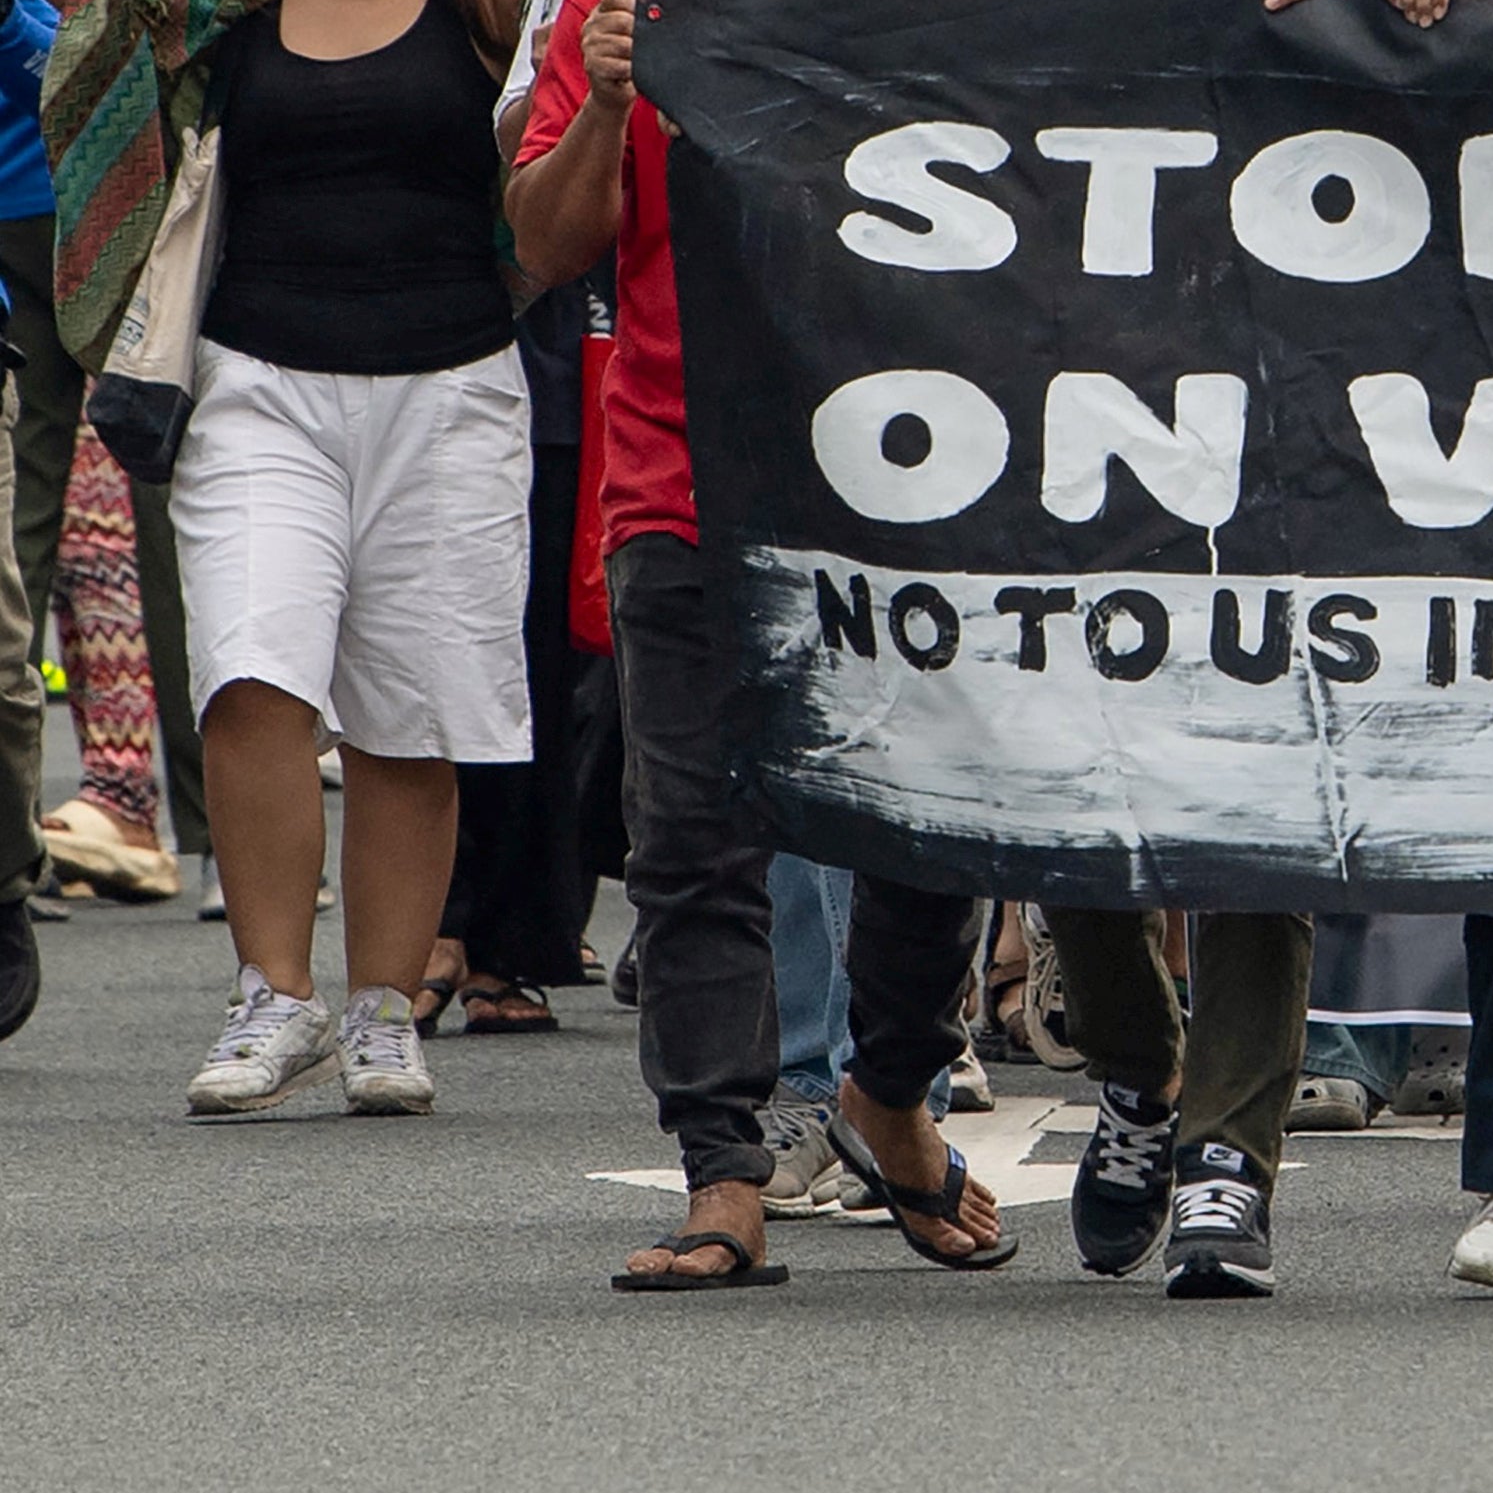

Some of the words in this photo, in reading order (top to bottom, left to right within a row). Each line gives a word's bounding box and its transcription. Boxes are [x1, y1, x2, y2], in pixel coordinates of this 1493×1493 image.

[811, 369, 1248, 528] ON
[814, 568, 960, 672] NO
[994, 584, 1171, 682] TO
[1209, 588, 1381, 686] US
